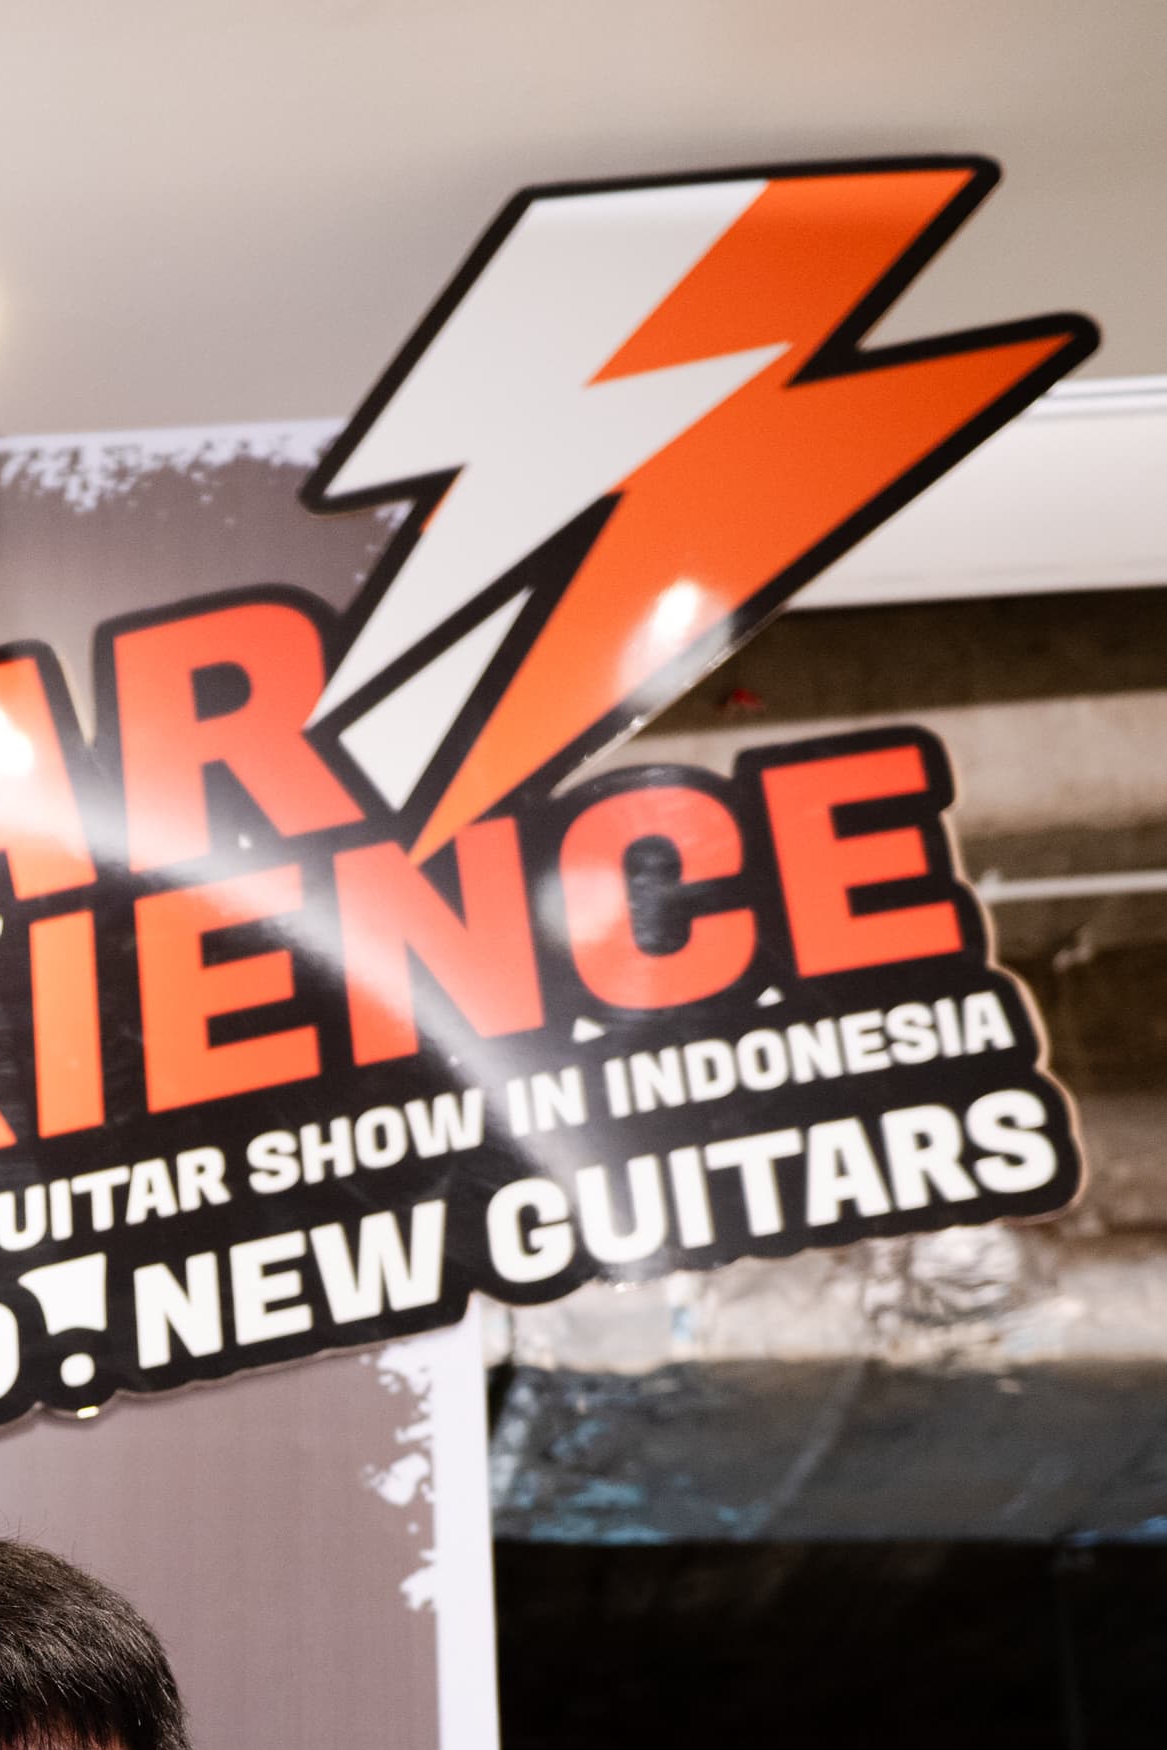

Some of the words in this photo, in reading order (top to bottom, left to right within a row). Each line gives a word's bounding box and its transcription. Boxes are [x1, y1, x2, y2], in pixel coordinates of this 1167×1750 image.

[246, 1087, 485, 1194] SHOW
[506, 1068, 586, 1137] IN
[603, 992, 1015, 1120] INDONESIA
[133, 1198, 446, 1370] NEW
[485, 1090, 1058, 1286] GUITARS
